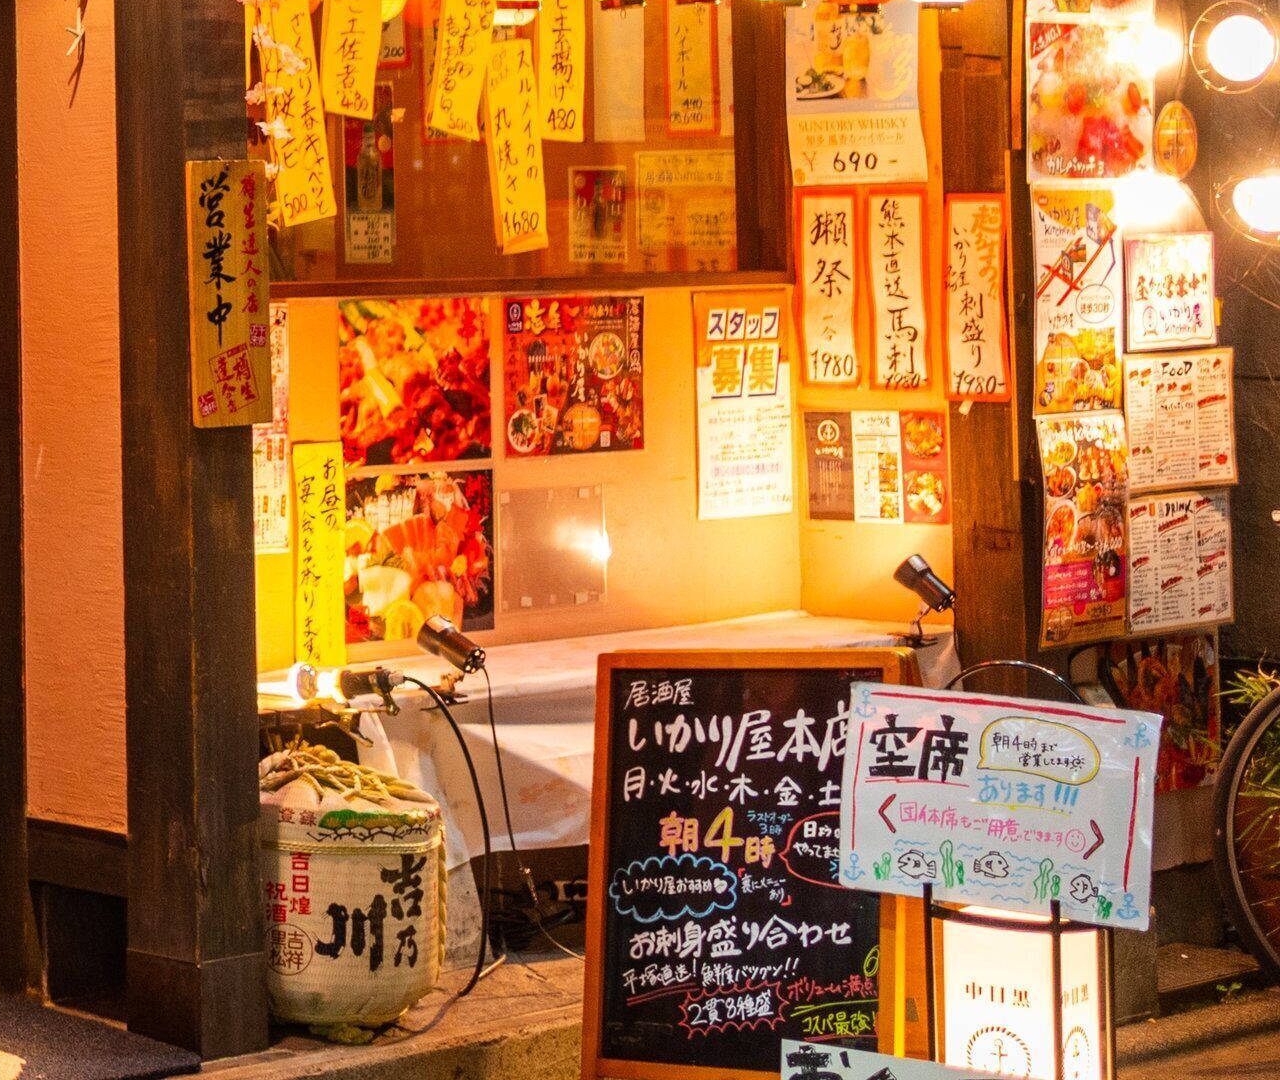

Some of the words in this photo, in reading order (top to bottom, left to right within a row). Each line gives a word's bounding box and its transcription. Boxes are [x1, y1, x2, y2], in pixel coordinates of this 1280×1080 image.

[799, 119, 854, 133] SUNTORY
[858, 117, 908, 130] WHISKY
[199, 170, 236, 349] 営業中
[709, 311, 778, 337] スタッフ
[712, 345, 776, 394] 募集
[624, 678, 695, 711] 居酒屋
[628, 699, 850, 772] いかり屋本店
[869, 713, 969, 783] 空席
[659, 806, 777, 869] 朝4時
[629, 914, 852, 960] お刺身盛り合わせ
[965, 982, 1032, 1009] 中目黒
